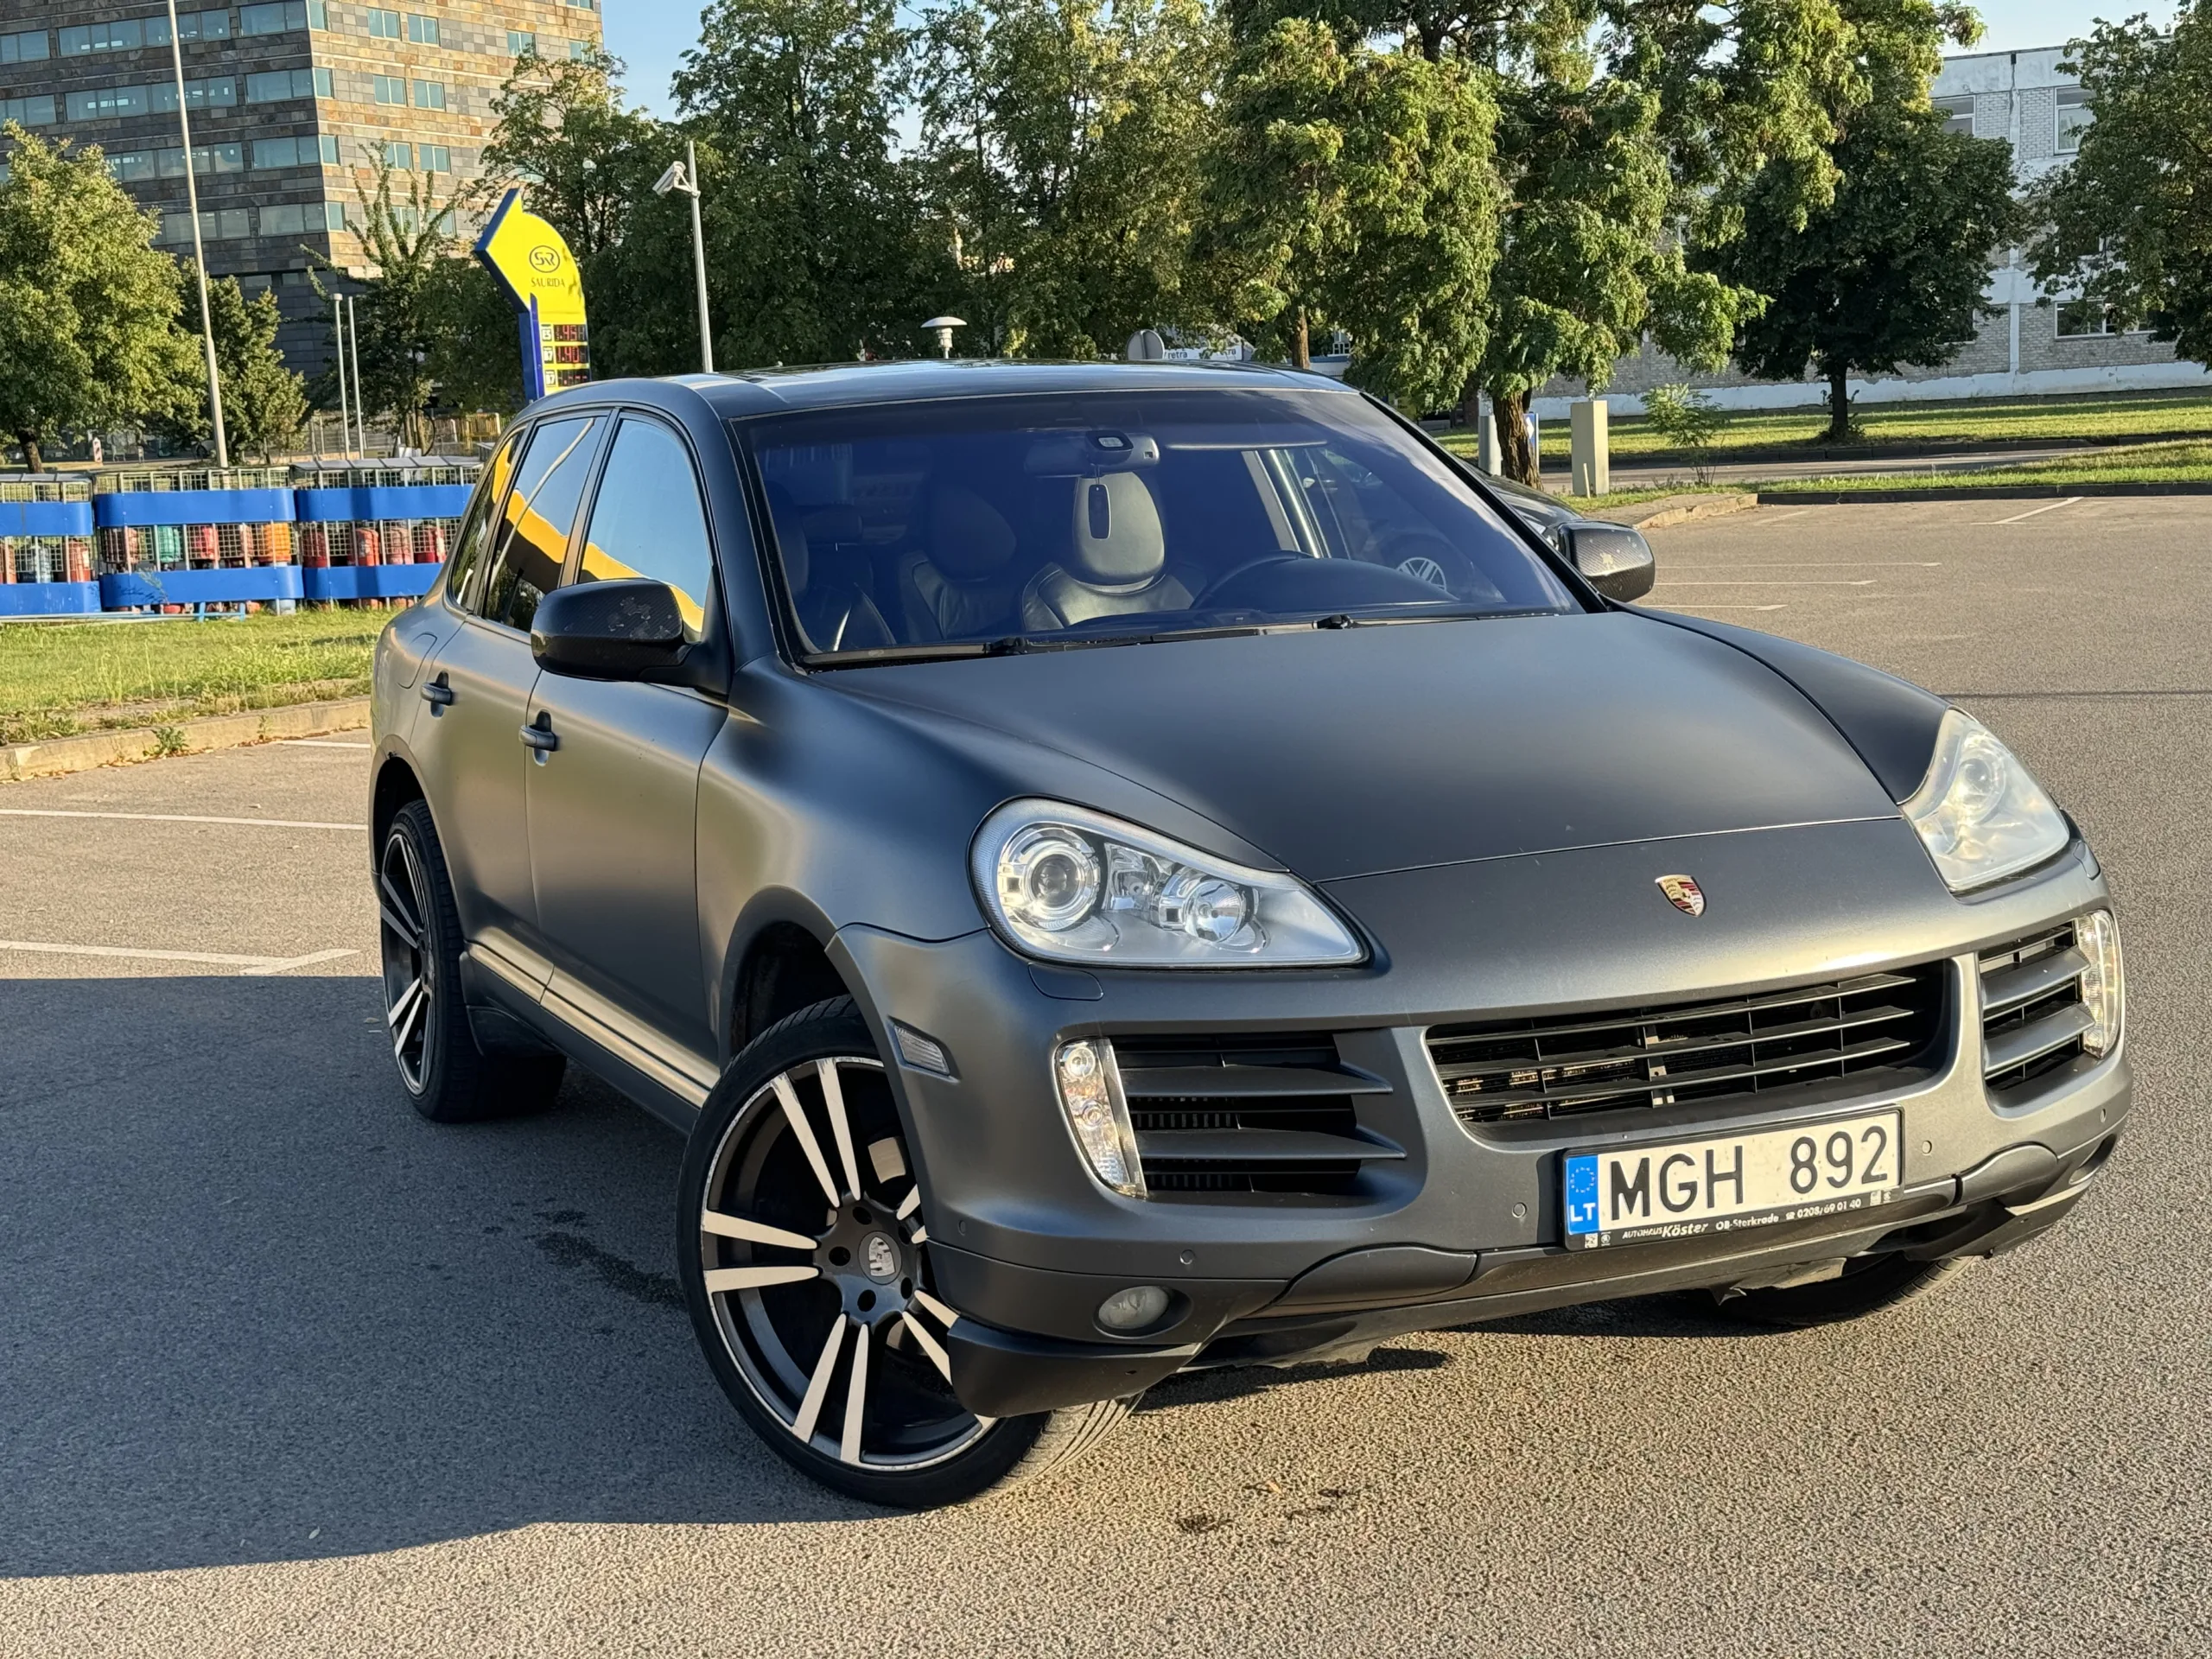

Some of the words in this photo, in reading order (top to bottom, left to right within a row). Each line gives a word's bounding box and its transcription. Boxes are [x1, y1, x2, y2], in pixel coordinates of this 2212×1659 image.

[531, 276, 566, 288] SAURIDA
[1570, 1202, 1596, 1223] LT
[1610, 1145, 1744, 1221] MGH
[1790, 1125, 1889, 1194] 892
[1622, 1227, 1662, 1240] AUTOHAUS
[1662, 1222, 1709, 1238] Köster
